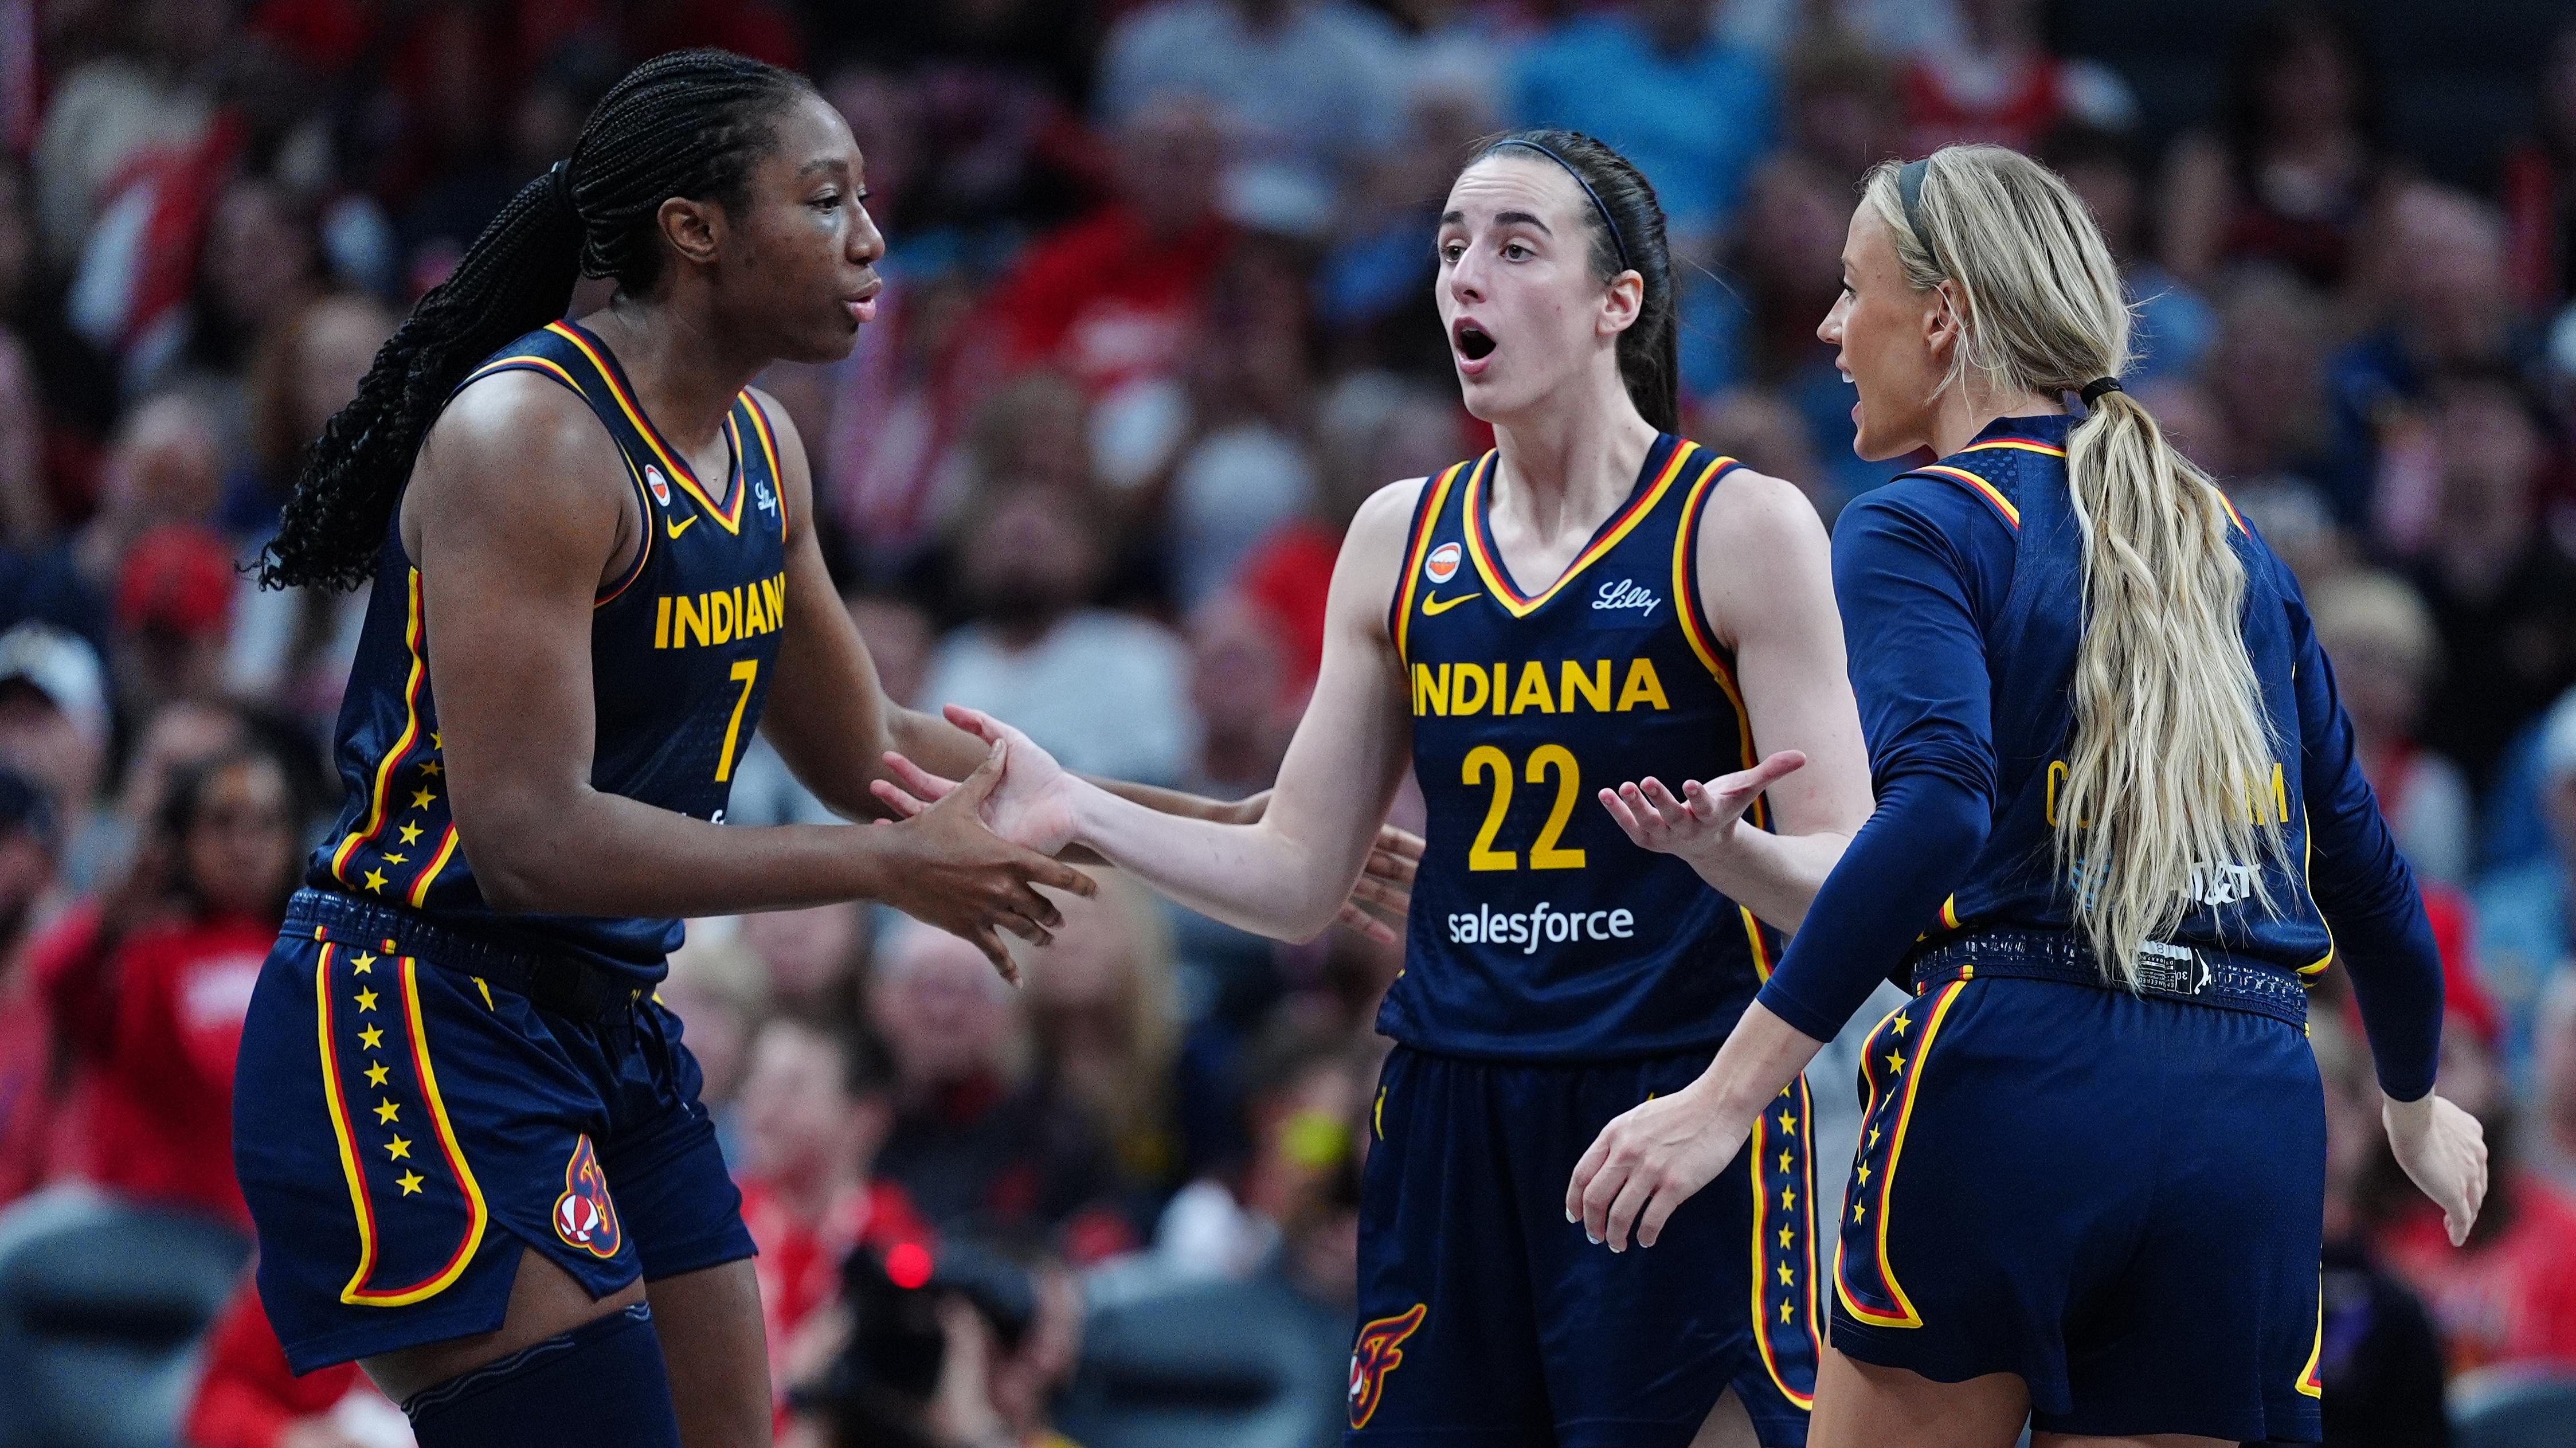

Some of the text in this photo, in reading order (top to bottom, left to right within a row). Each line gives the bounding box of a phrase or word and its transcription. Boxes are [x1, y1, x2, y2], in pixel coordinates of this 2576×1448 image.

[1592, 579, 1661, 617] Lilly
[1412, 658, 1670, 717] INDIANA
[715, 659, 758, 782] 7
[1462, 743, 1586, 871] 22
[2170, 860, 2261, 906] T&T
[1448, 902, 1634, 955] salesforce
